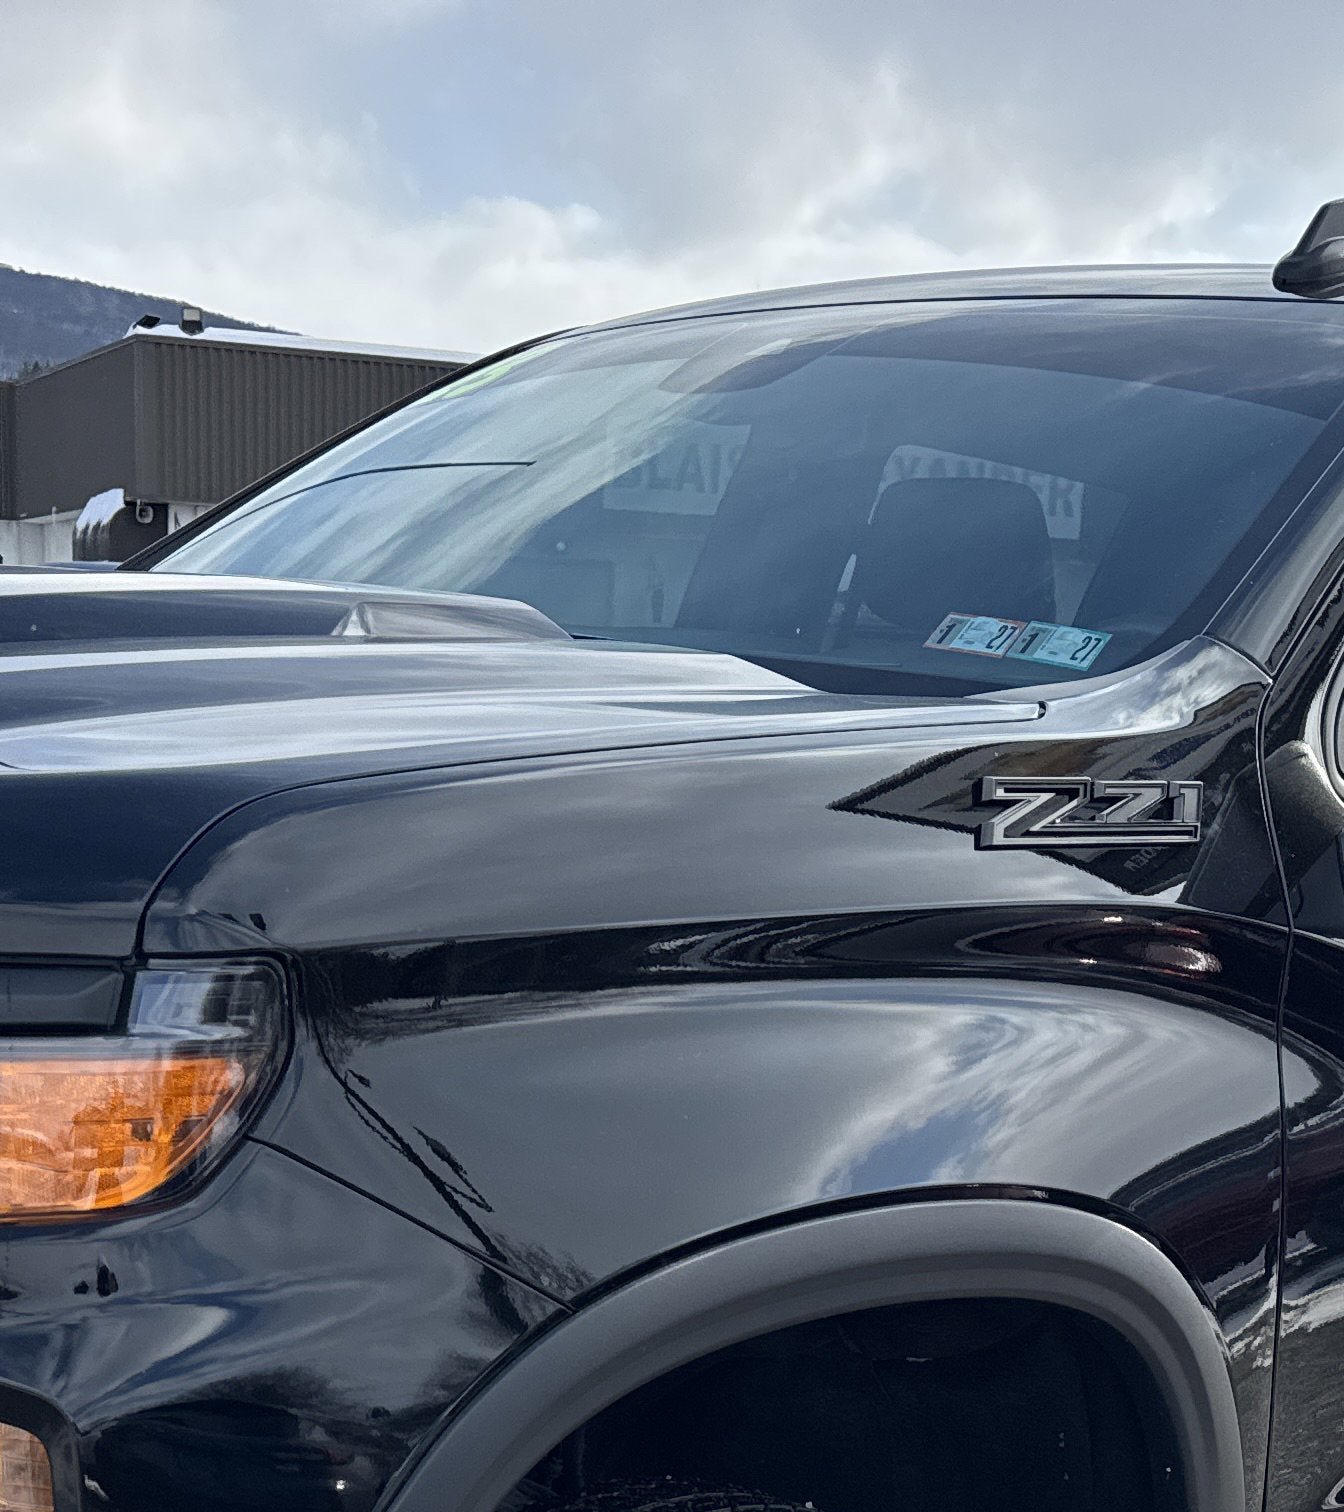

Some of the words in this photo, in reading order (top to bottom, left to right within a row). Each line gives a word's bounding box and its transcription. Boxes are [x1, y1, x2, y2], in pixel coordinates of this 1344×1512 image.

[985, 624, 1019, 652] 27
[1069, 635, 1103, 663] 27
[971, 776, 1204, 851] Z71
